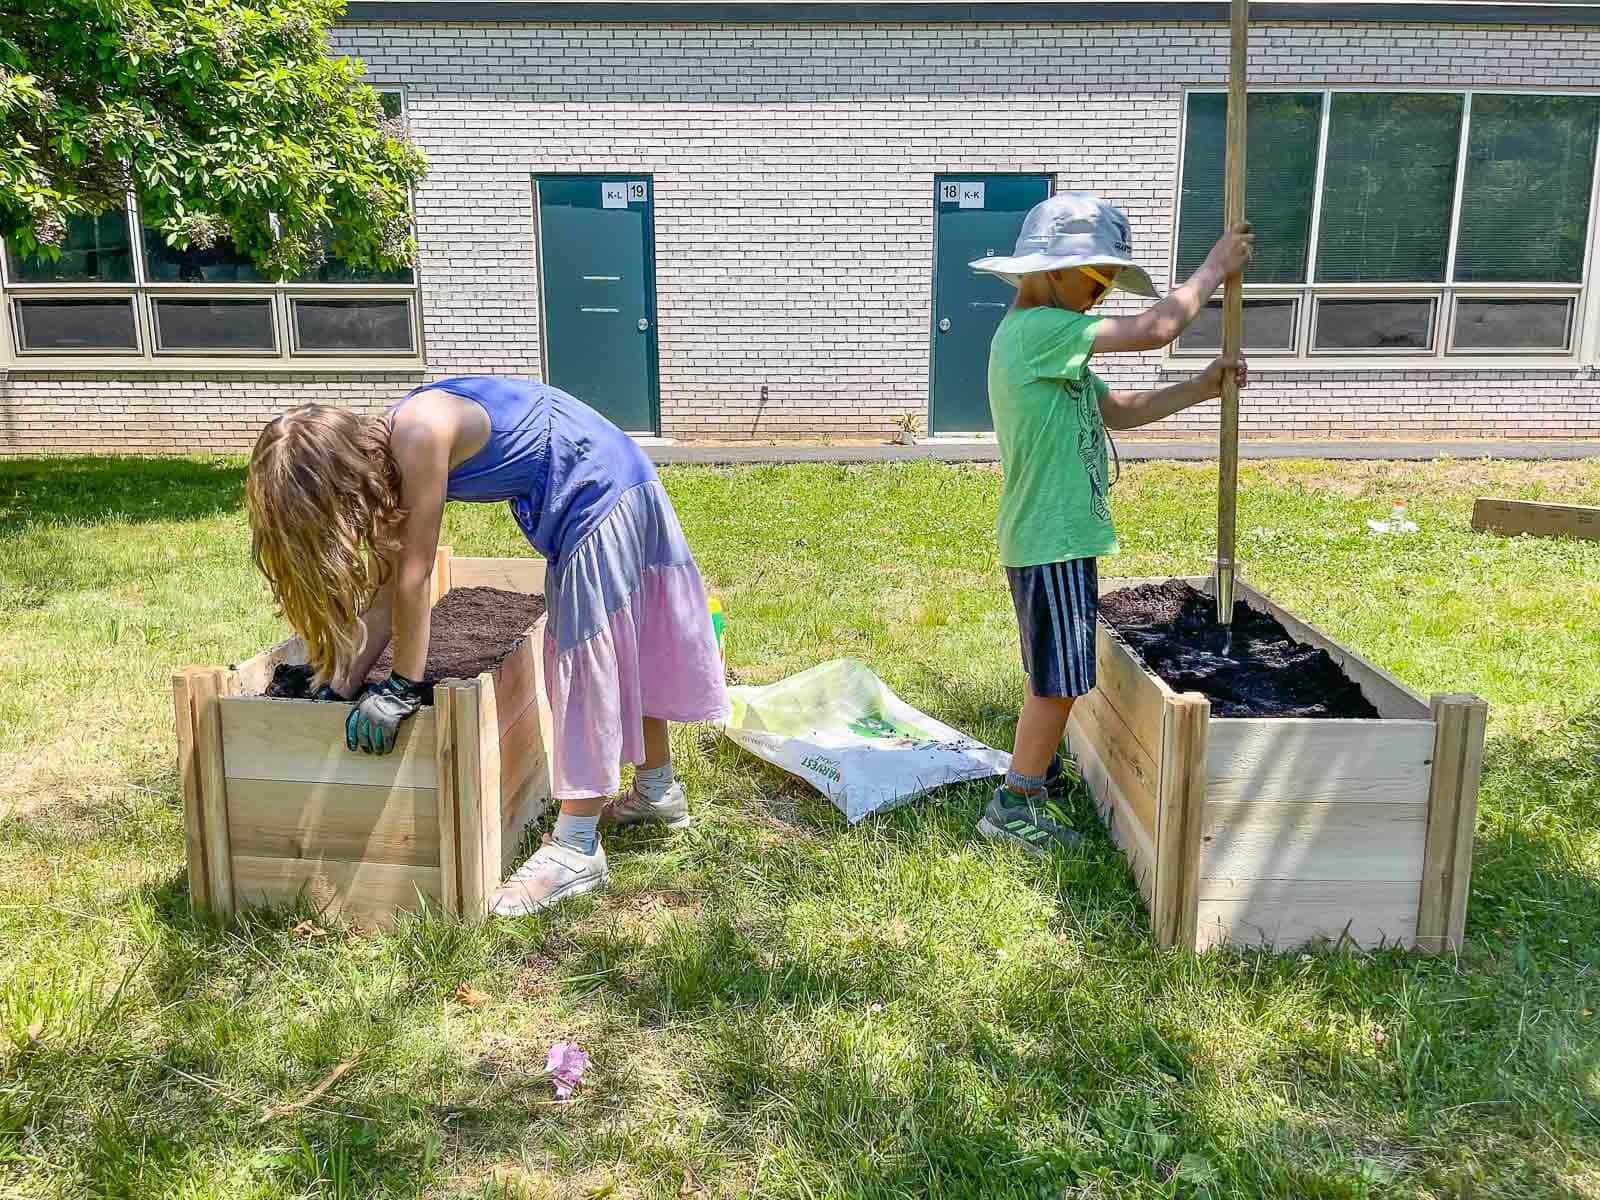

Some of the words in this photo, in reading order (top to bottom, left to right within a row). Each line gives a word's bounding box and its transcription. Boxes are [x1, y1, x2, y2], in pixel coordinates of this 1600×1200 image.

[607, 191, 622, 199] K-L
[631, 184, 644, 198] 19
[943, 185, 957, 198] 18
[964, 191, 979, 200] K-K
[801, 757, 841, 783] HARVEST
